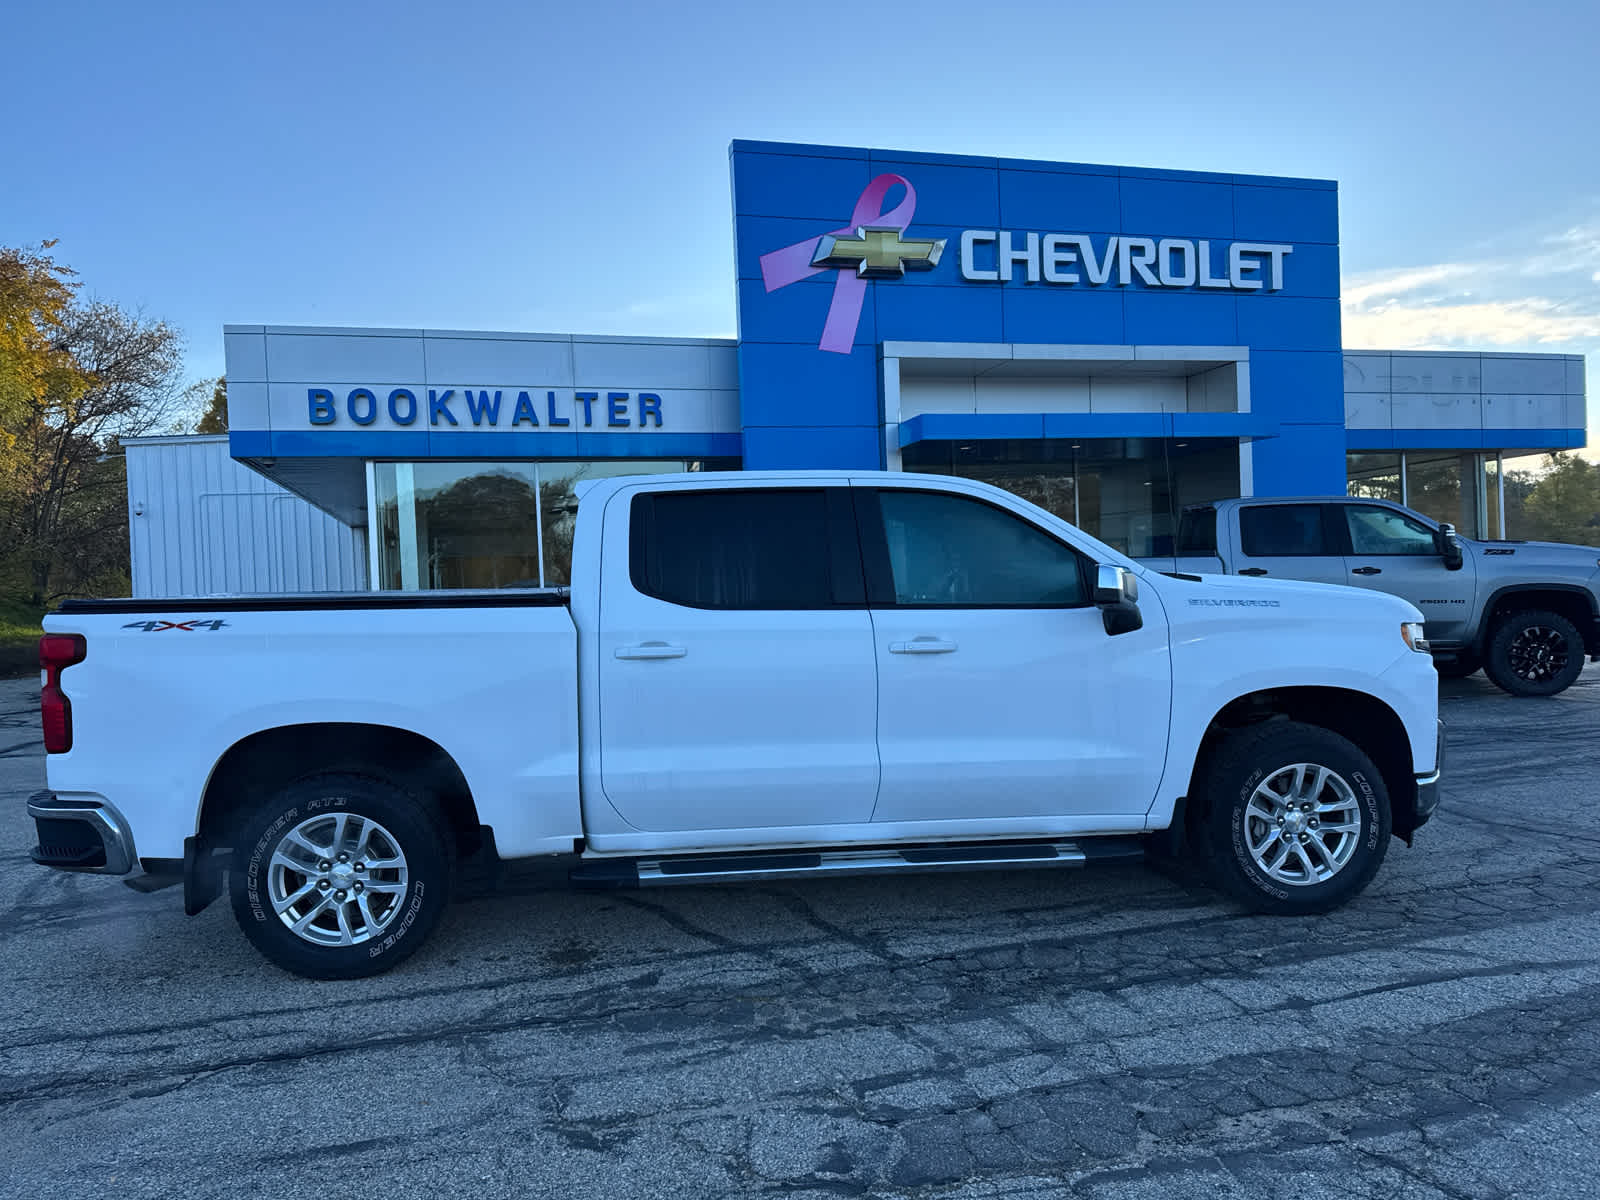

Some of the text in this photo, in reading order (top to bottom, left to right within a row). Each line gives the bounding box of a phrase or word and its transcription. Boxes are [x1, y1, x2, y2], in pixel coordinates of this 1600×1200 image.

[960, 229, 1293, 291] CHEVROLET
[307, 387, 664, 427] BOOKWALTER
[1352, 771, 1380, 849] COOPER
[247, 807, 299, 921] DISCOVERER
[368, 880, 425, 958] COOPER
